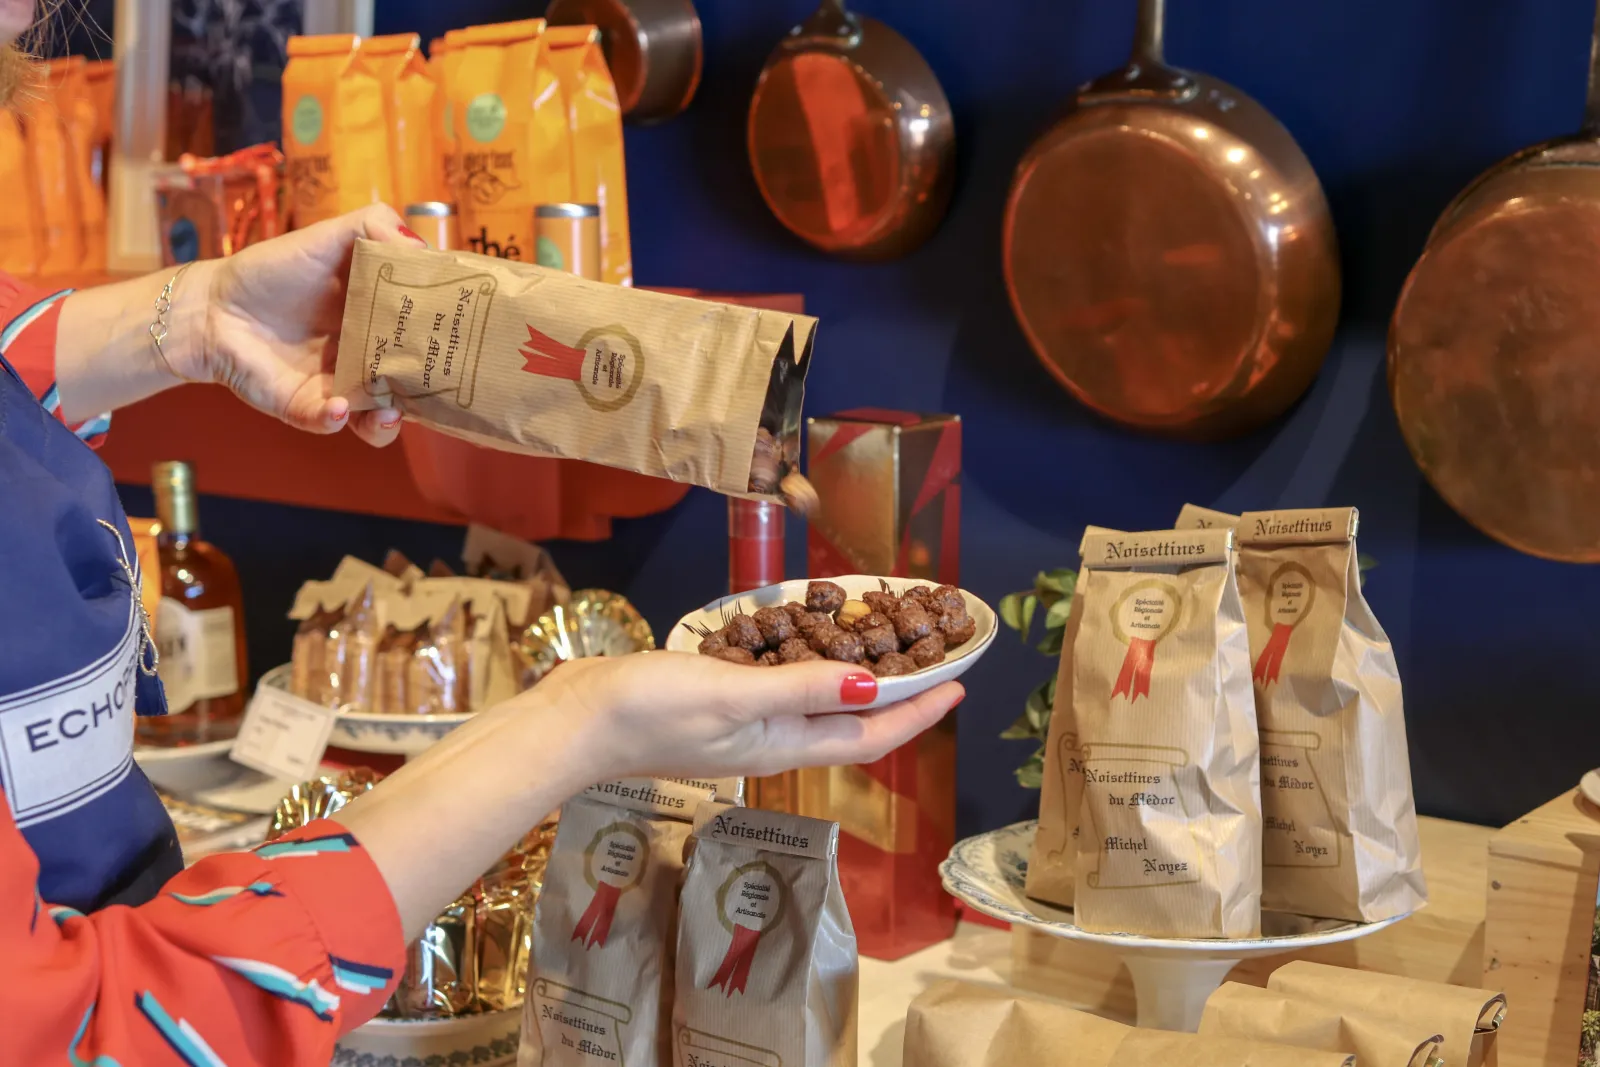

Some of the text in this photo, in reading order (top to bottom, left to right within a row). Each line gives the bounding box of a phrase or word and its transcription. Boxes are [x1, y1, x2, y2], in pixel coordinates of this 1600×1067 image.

[393, 294, 414, 348] Michel
[443, 287, 474, 376] Noisettines
[369, 335, 388, 384] Noyez
[422, 312, 446, 389] du Médoc
[602, 364, 608, 373] et
[1252, 518, 1333, 537] Noisettines
[1103, 541, 1206, 563] Noisettines
[1130, 621, 1161, 629] Artisanale
[1085, 768, 1161, 787] Noisettines
[1278, 775, 1315, 791] Médoc
[1108, 792, 1176, 810] du Médoc
[711, 814, 810, 850] Noisettines
[1104, 837, 1148, 854] Michel
[1293, 840, 1329, 859] Noyez
[1143, 858, 1188, 877] Noyez
[735, 907, 767, 919] Artisanale
[542, 1004, 607, 1036] Noisettines
[560, 1033, 617, 1062] du Médoc
